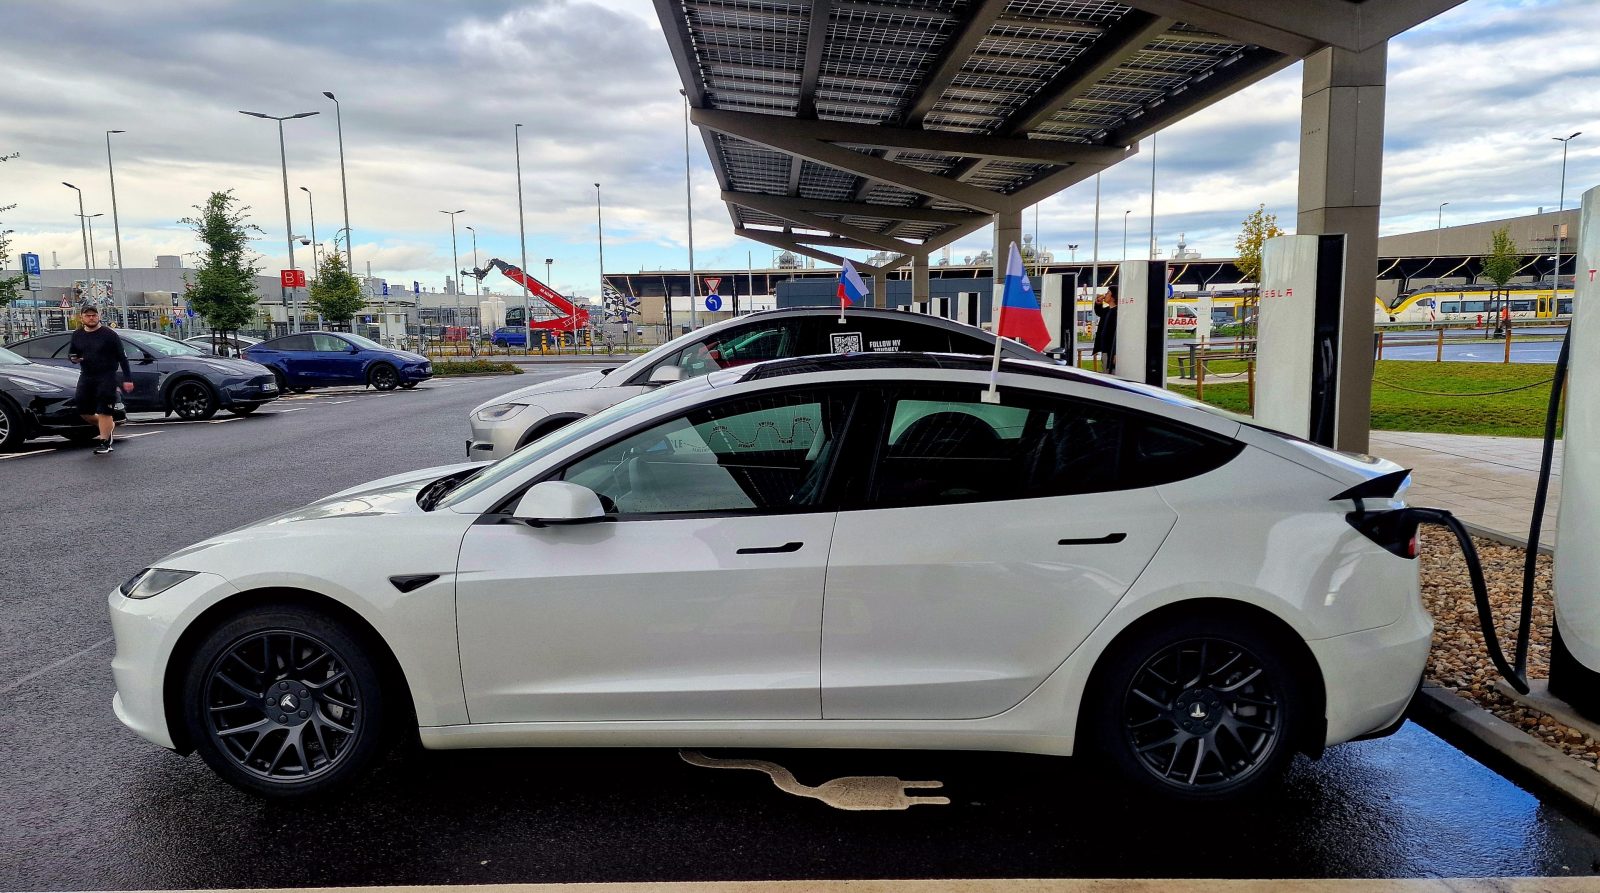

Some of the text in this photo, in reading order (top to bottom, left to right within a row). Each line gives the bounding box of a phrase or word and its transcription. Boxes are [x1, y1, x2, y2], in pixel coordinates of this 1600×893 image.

[28, 256, 36, 271] P
[284, 271, 295, 284] B
[869, 339, 901, 348] FOLLOW MY
